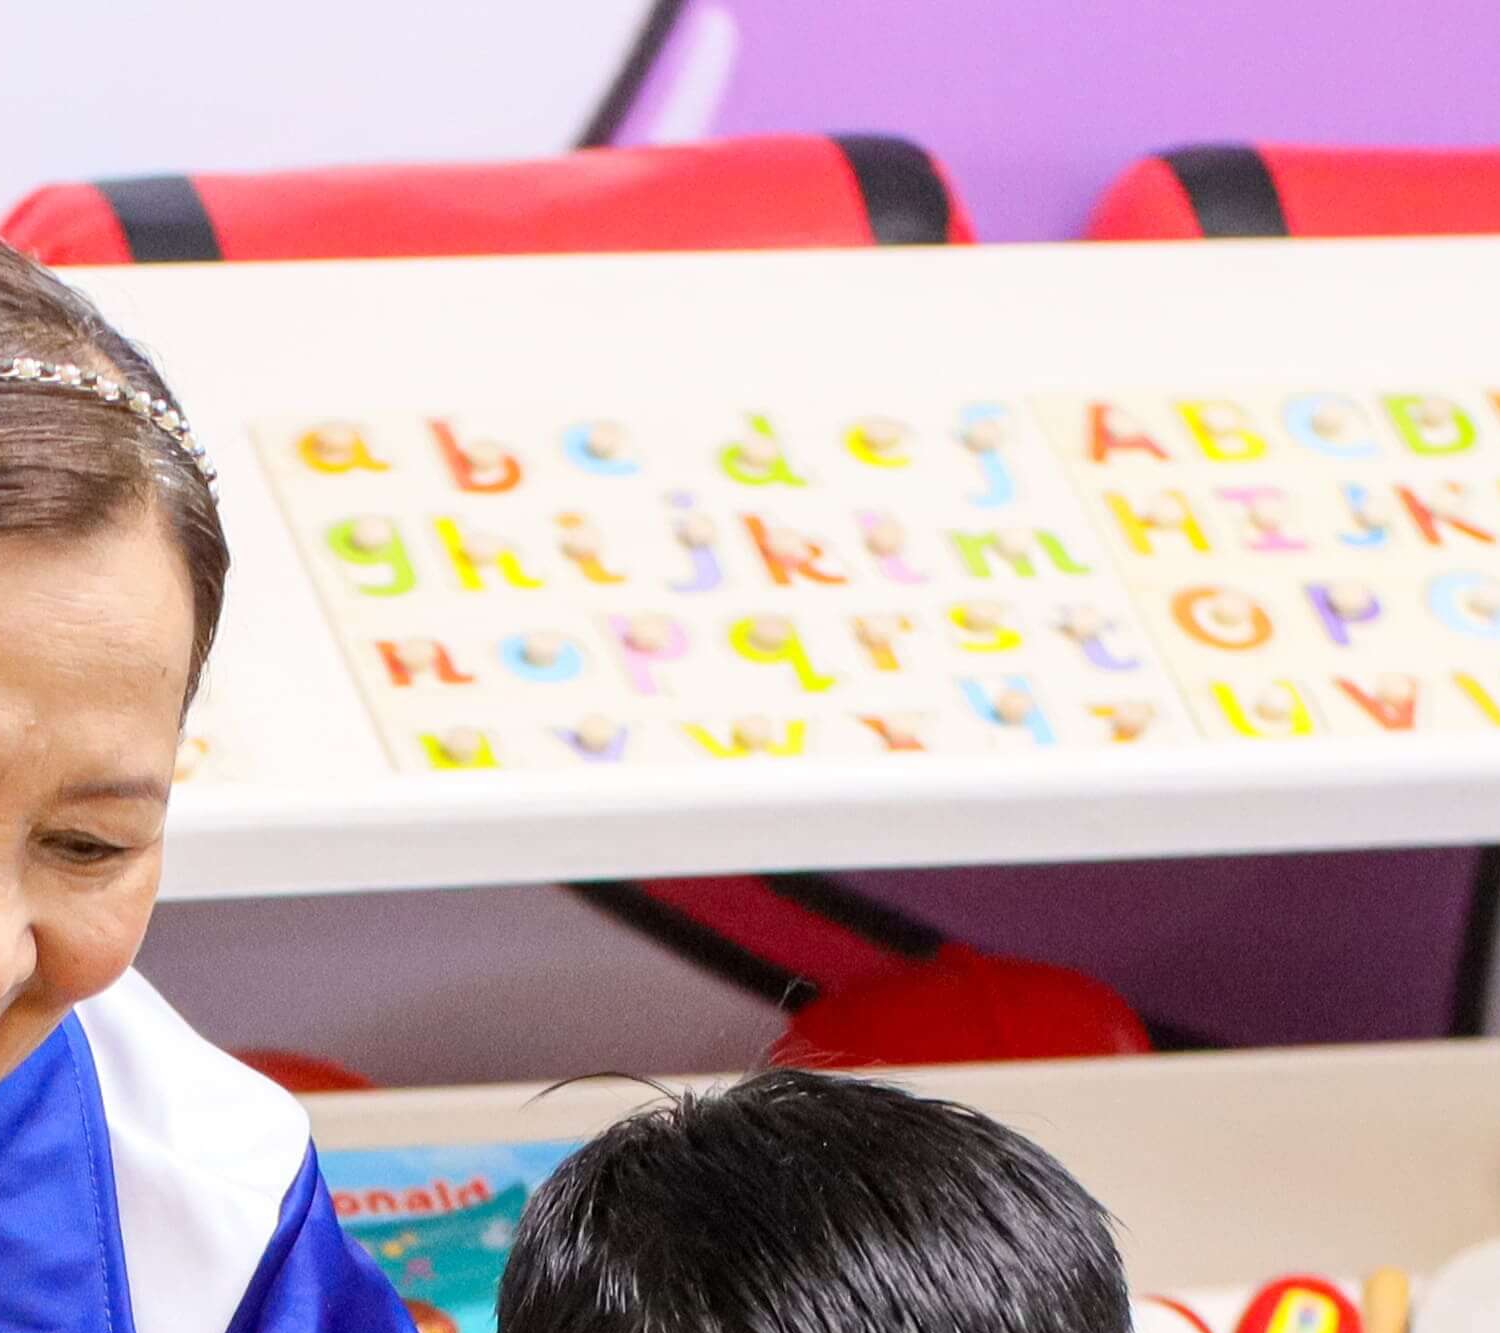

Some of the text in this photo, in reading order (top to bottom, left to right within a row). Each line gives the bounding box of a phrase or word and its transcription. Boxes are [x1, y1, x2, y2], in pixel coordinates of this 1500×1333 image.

[1085, 402, 1171, 464] A
[1173, 400, 1266, 461] B
[1282, 393, 1382, 455] C
[1384, 395, 1477, 455] D
[1103, 490, 1212, 554] H
[1215, 486, 1308, 552] I
[1339, 484, 1388, 547] J
[1395, 482, 1495, 546] K
[1171, 585, 1274, 650] O
[1307, 584, 1382, 645] P
[1210, 679, 1314, 738] U
[1334, 677, 1419, 731] V
